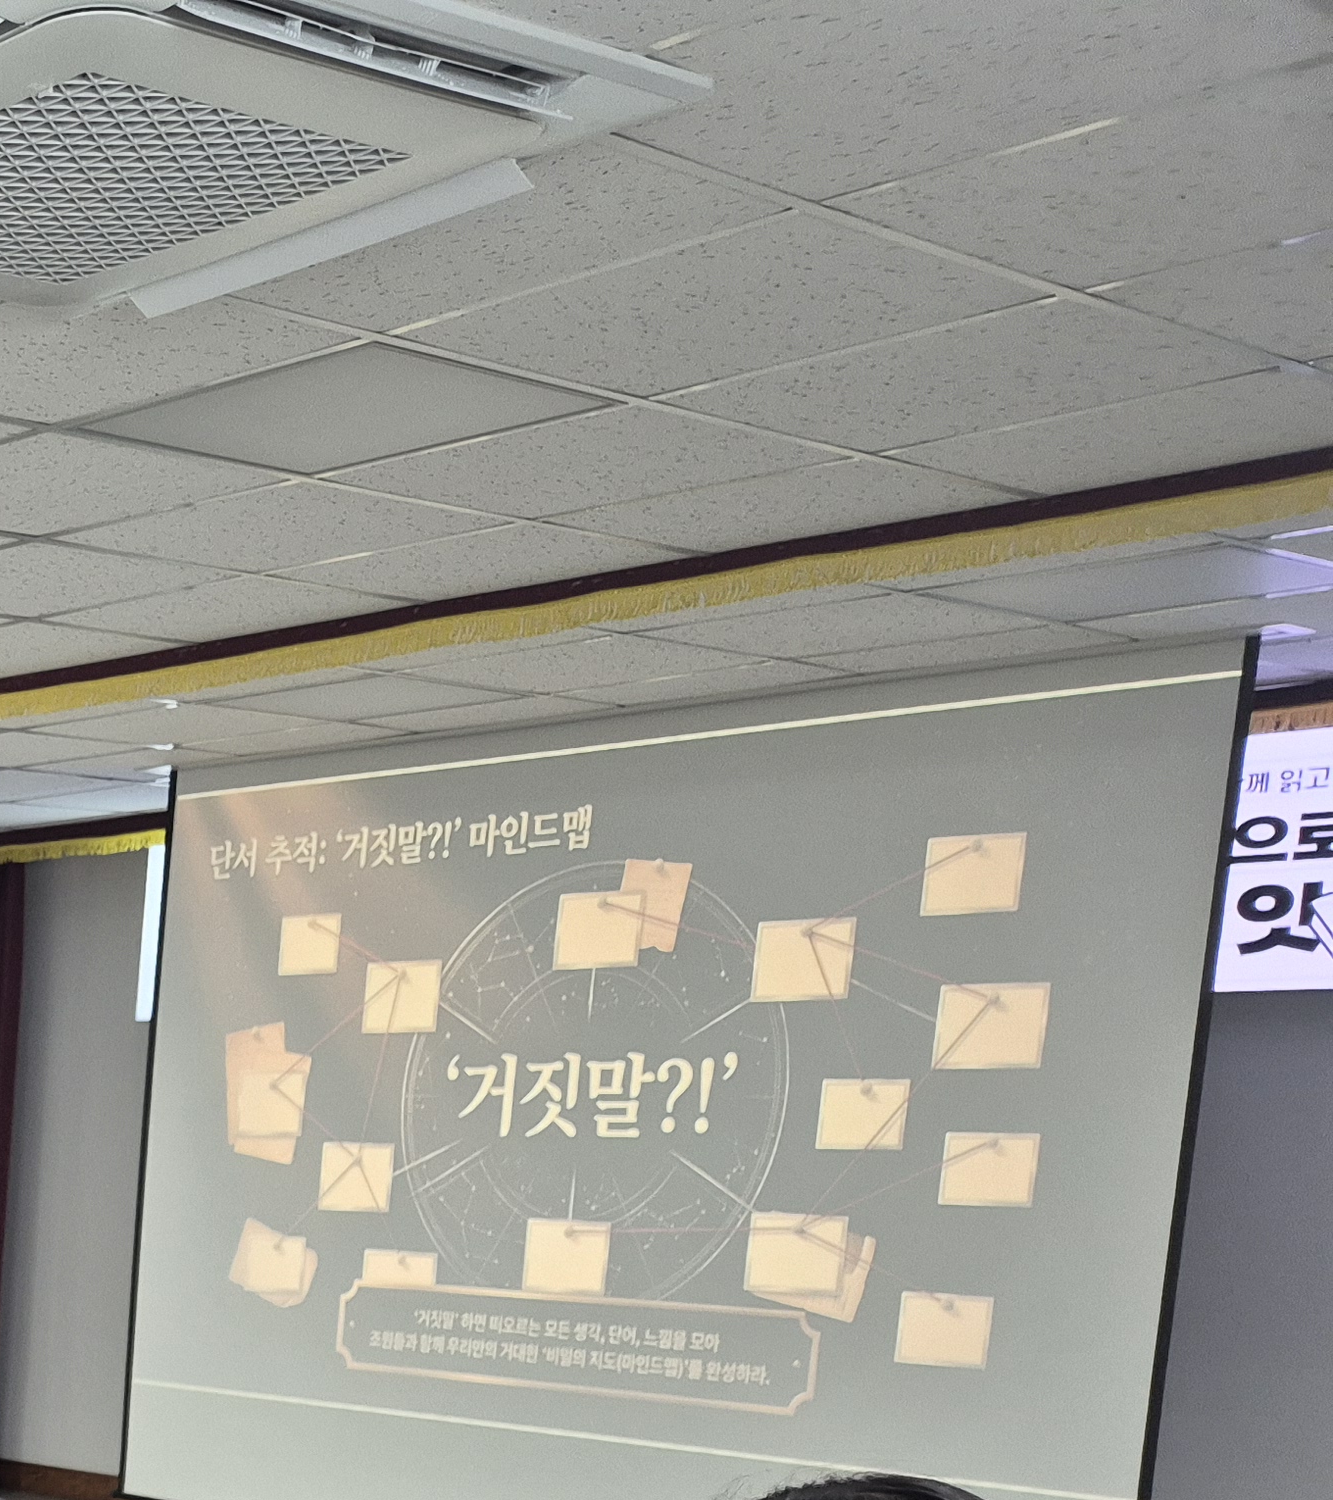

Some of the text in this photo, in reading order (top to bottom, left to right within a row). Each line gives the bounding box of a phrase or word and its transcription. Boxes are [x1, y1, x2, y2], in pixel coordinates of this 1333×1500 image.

[1279, 767, 1331, 793] 읽고
[210, 804, 593, 880] 단서 추적: ‘거짓말?!’ 마인드맵
[446, 1051, 739, 1138] ‘거짓말?!’
[420, 1333, 446, 1354] 함께
[447, 1337, 497, 1360] 우리만의
[461, 1312, 486, 1332] 하면
[544, 1318, 570, 1340] 모든
[573, 1321, 605, 1345] 생각,
[608, 1324, 640, 1348] 단어,
[644, 1328, 687, 1350] 느낌을
[689, 1332, 720, 1353] 모아
